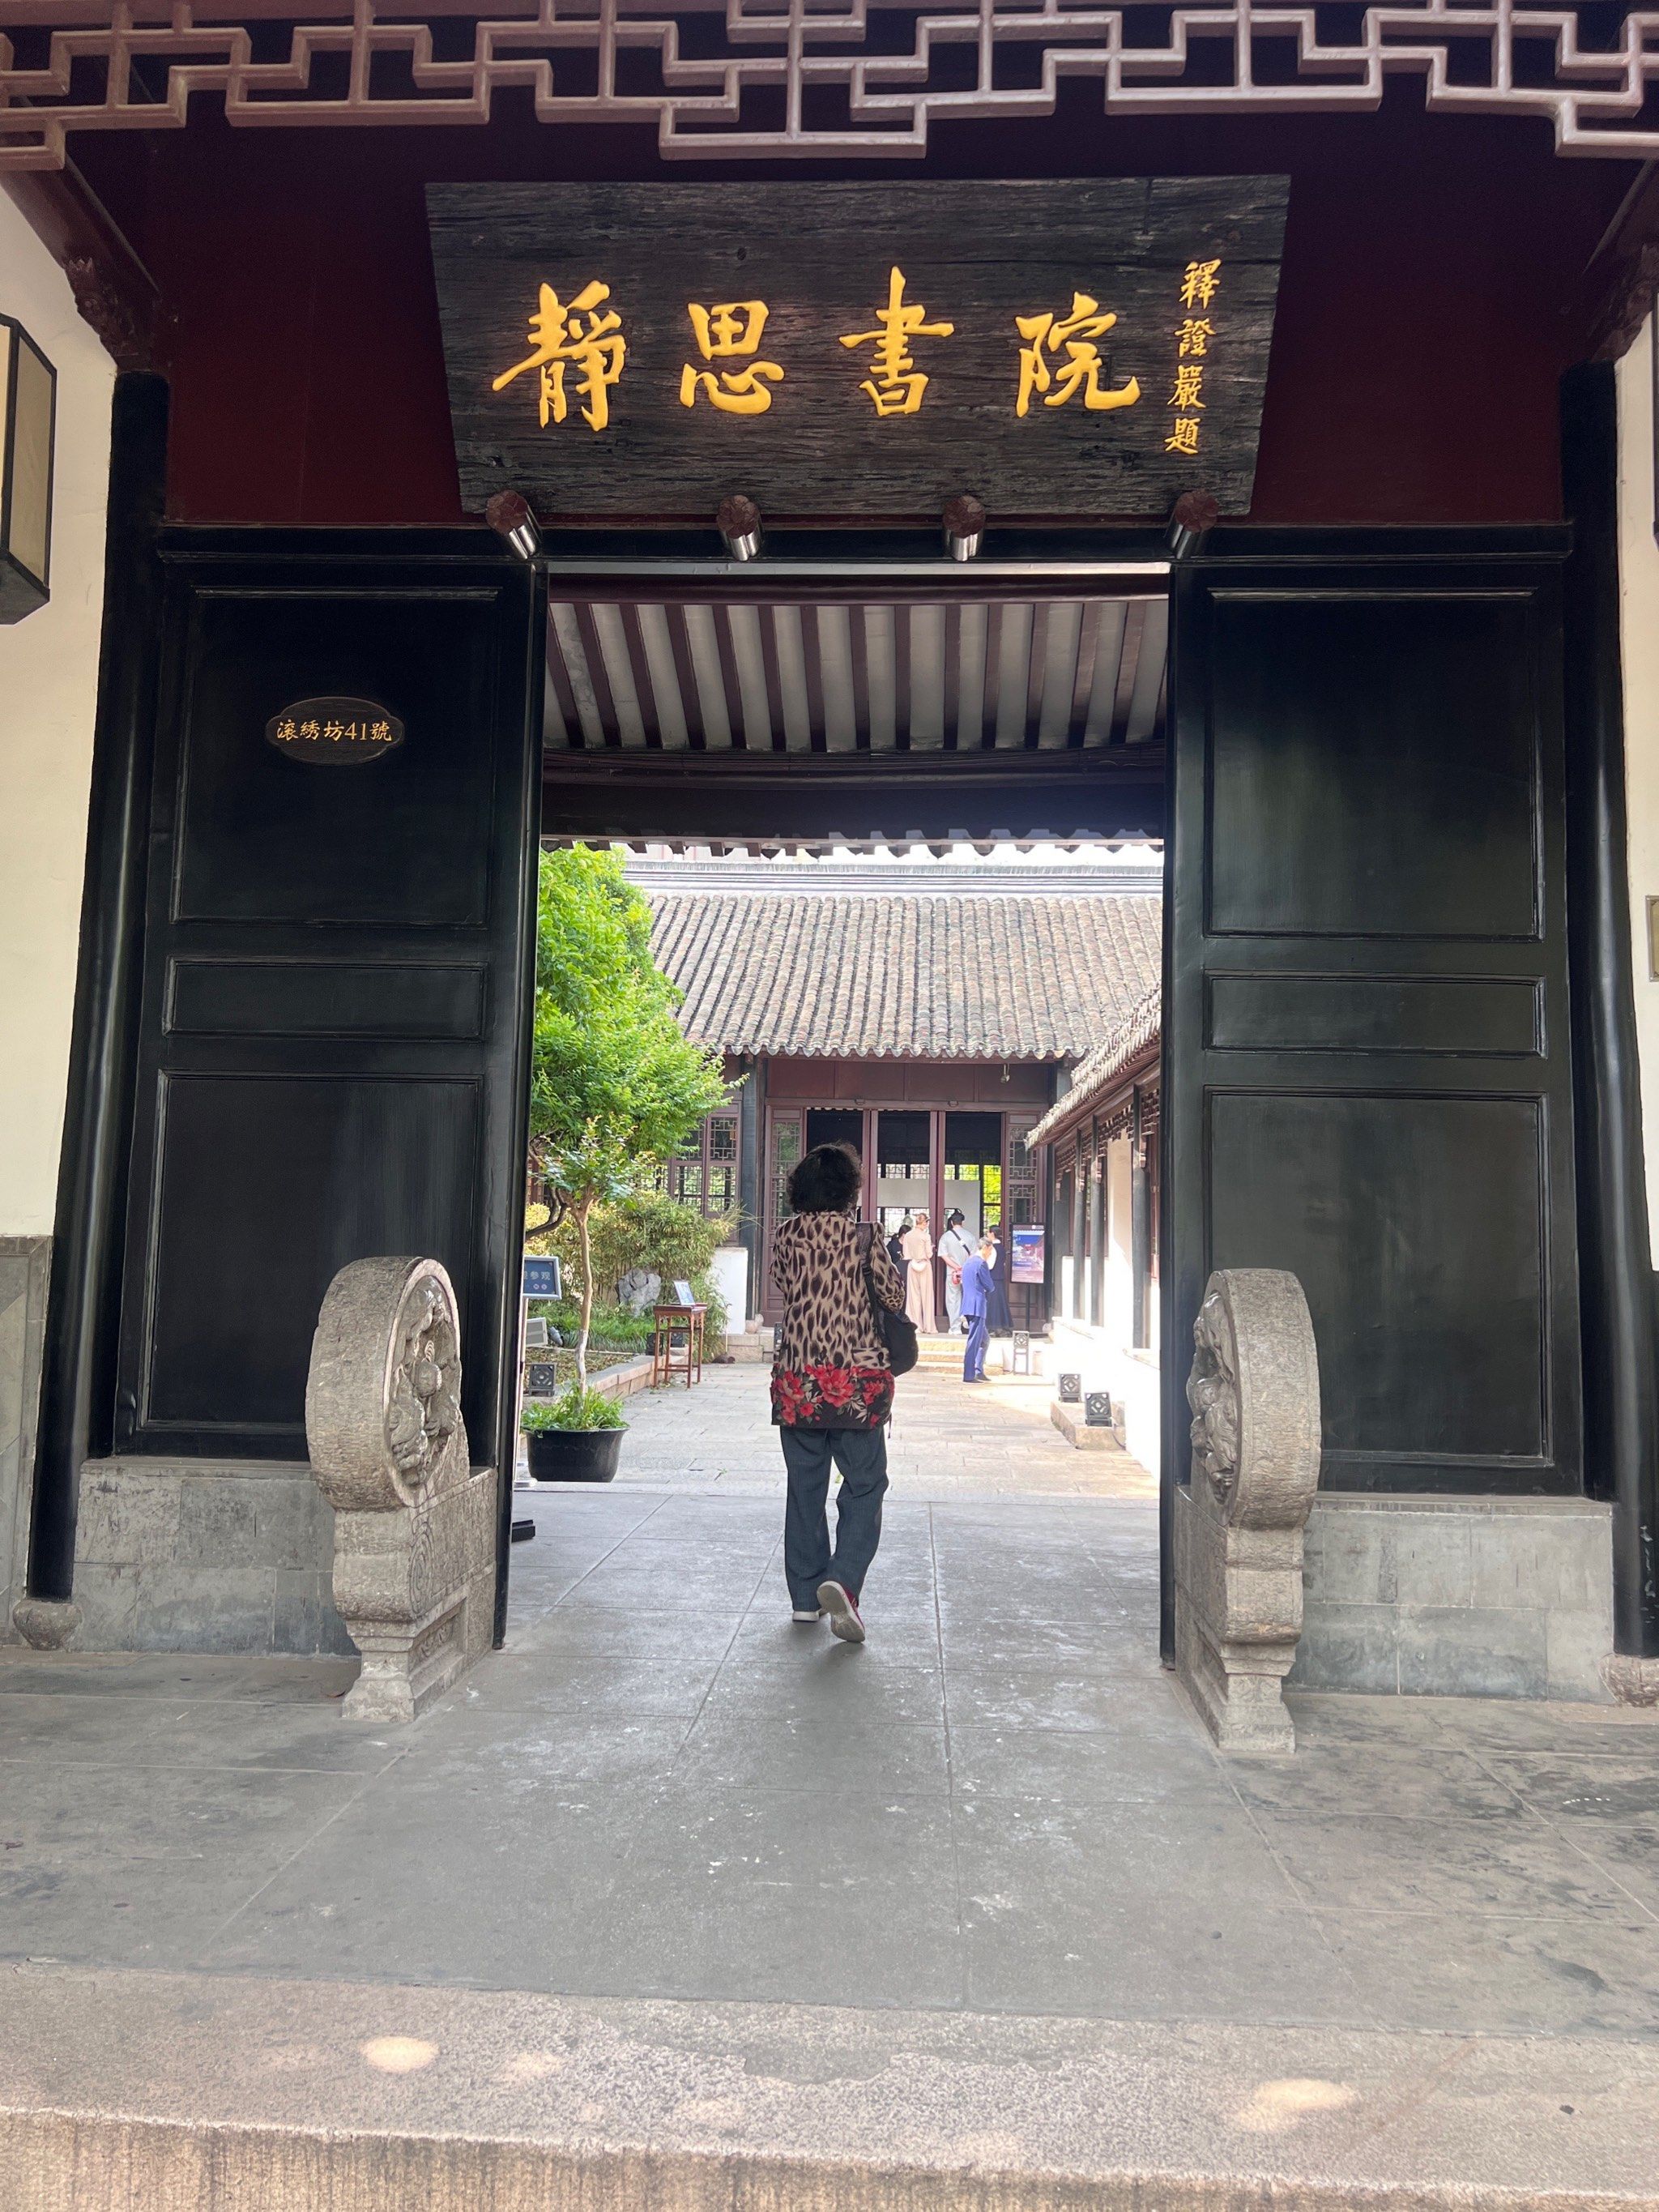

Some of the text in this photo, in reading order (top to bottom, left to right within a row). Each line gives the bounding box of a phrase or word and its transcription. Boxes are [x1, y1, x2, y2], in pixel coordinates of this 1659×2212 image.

[491, 267, 1141, 432] 靜思書院
[1165, 258, 1222, 455] 釋證嚴題
